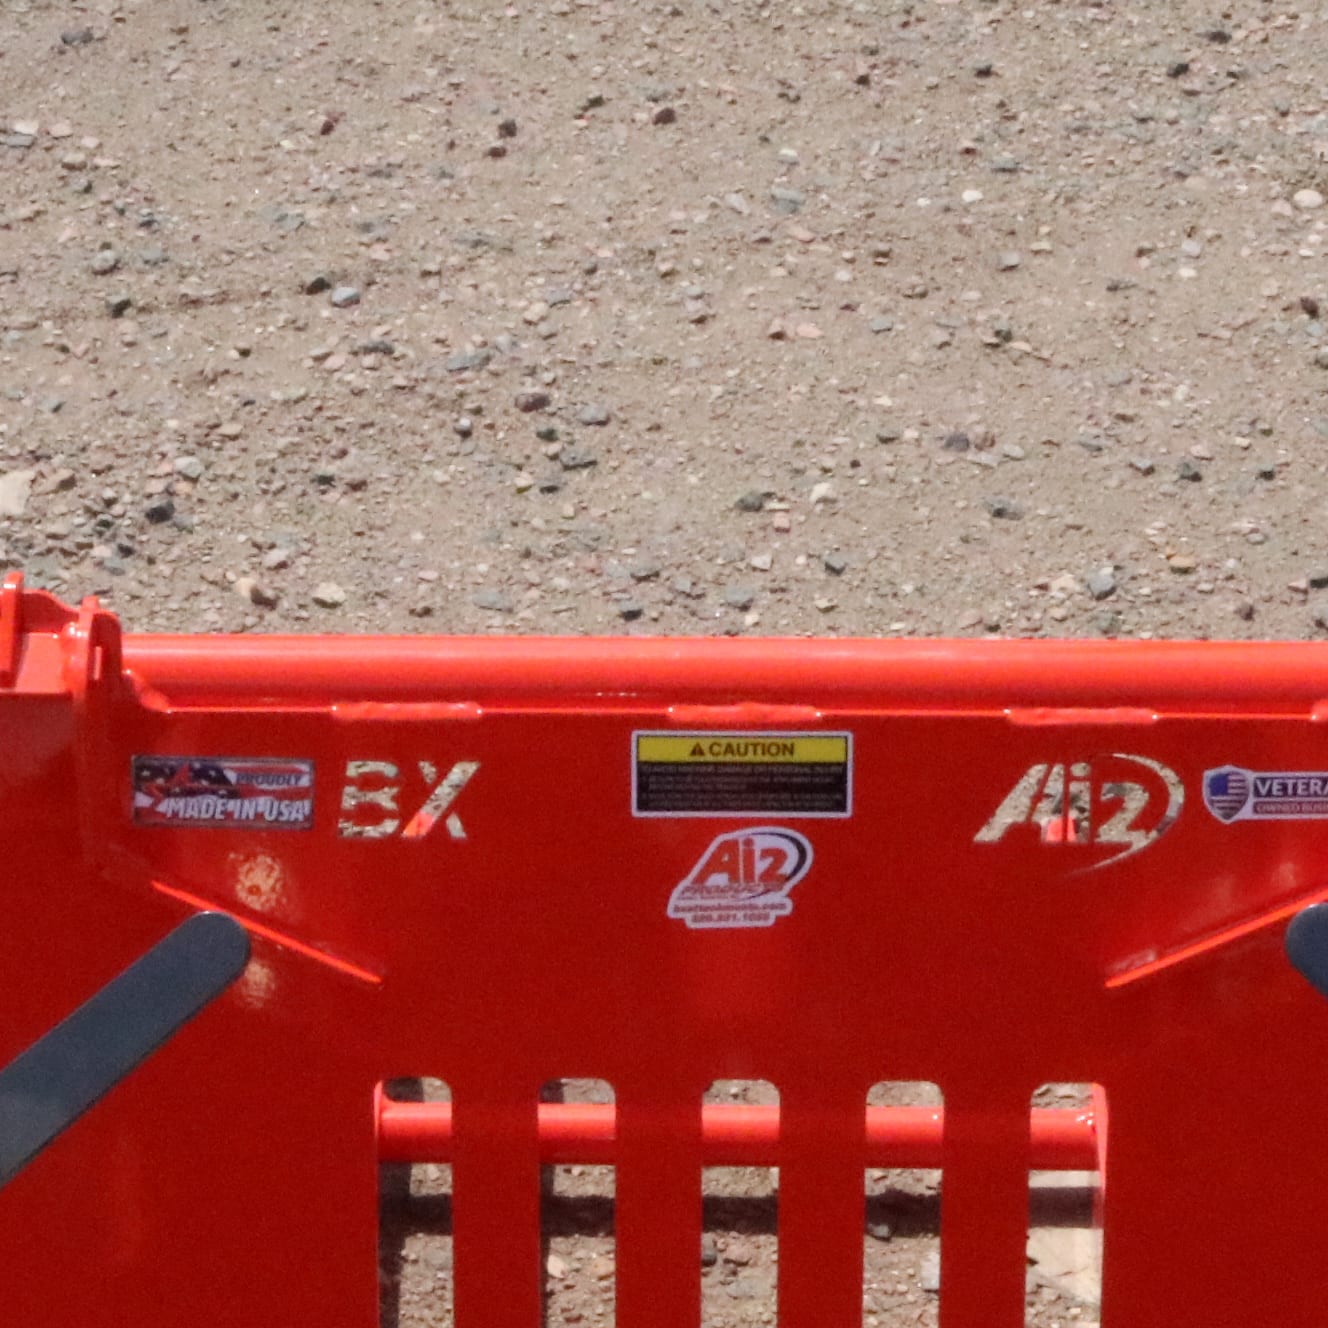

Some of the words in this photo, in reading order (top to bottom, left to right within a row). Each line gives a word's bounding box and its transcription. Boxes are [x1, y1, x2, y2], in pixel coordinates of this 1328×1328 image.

[708, 741, 795, 757] CAUTION
[235, 772, 302, 786] PROUDLY
[338, 760, 481, 839] BX
[165, 797, 225, 820] MADE
[231, 798, 255, 821] IN
[262, 799, 306, 823] USA
[1255, 803, 1301, 814] OWNED
